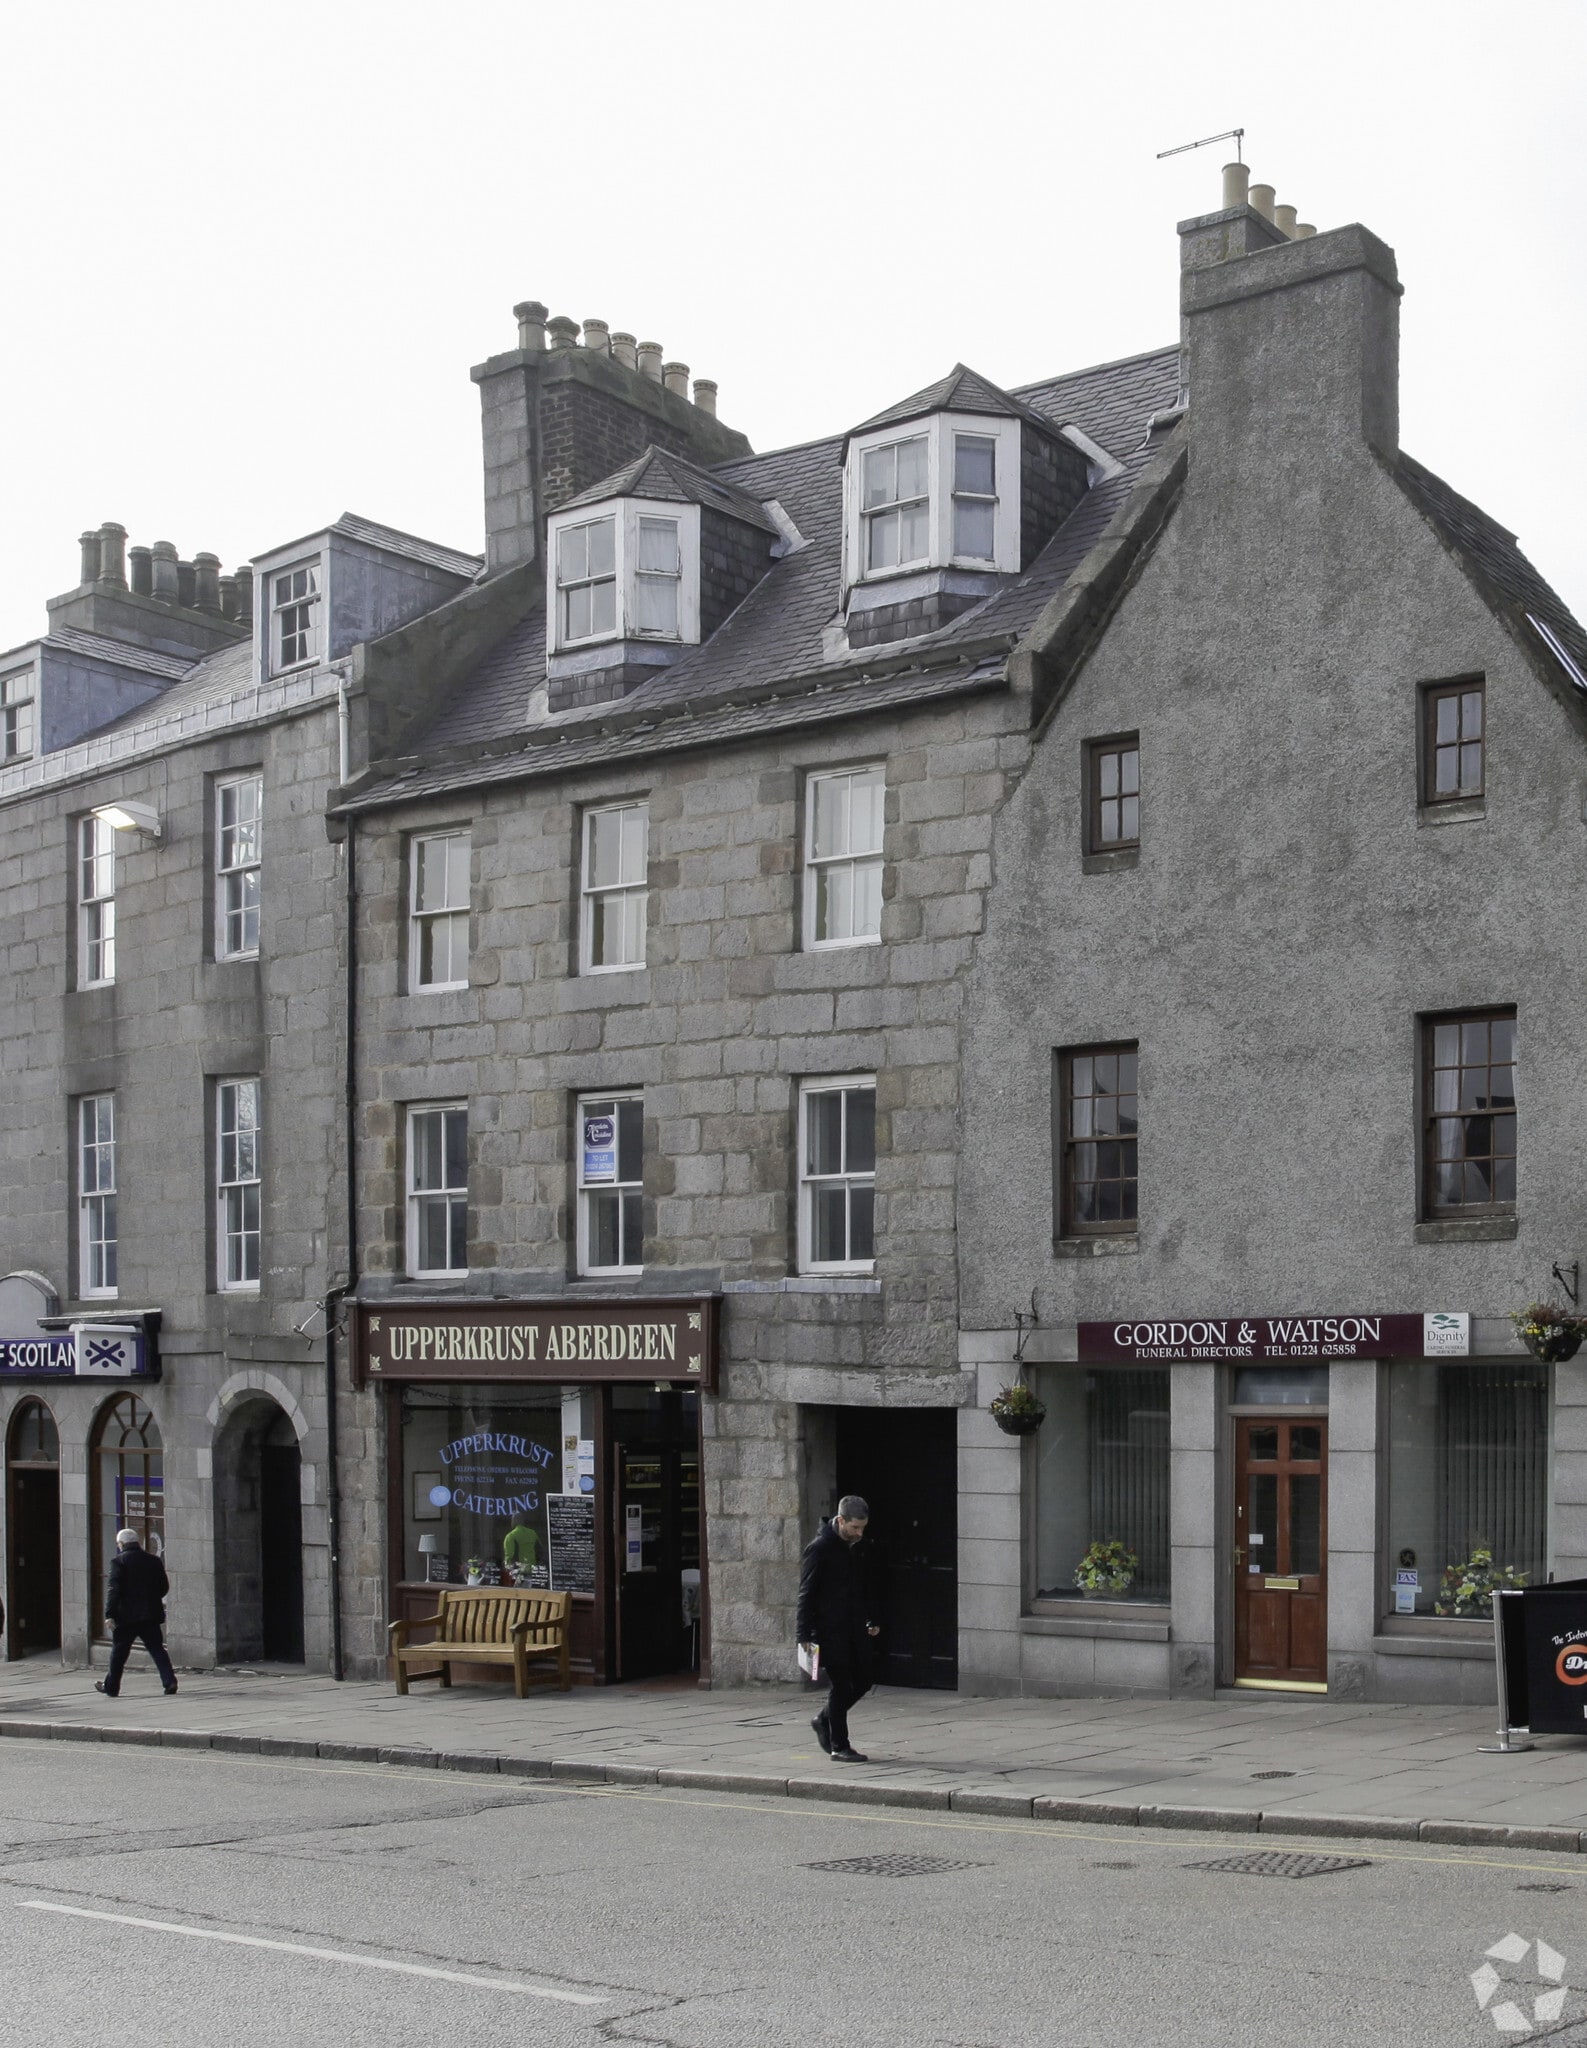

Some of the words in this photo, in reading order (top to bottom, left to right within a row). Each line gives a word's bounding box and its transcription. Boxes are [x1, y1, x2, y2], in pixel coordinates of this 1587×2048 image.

[389, 1325, 539, 1361] UPPERKRUST
[545, 1324, 677, 1361] ABERDEEN
[1113, 1321, 1228, 1347] GORDON
[1237, 1321, 1257, 1344] &
[1267, 1317, 1382, 1343] WATSON
[1427, 1330, 1466, 1345] Dignity
[9, 1343, 76, 1367] SCOTLAN
[1135, 1347, 1188, 1359] FUNERAL
[1264, 1345, 1288, 1356] TEL:
[1290, 1344, 1319, 1356] 01224
[1321, 1343, 1357, 1355] 625858
[439, 1433, 554, 1468] UPPERKRUST
[453, 1488, 539, 1516] CATERING
